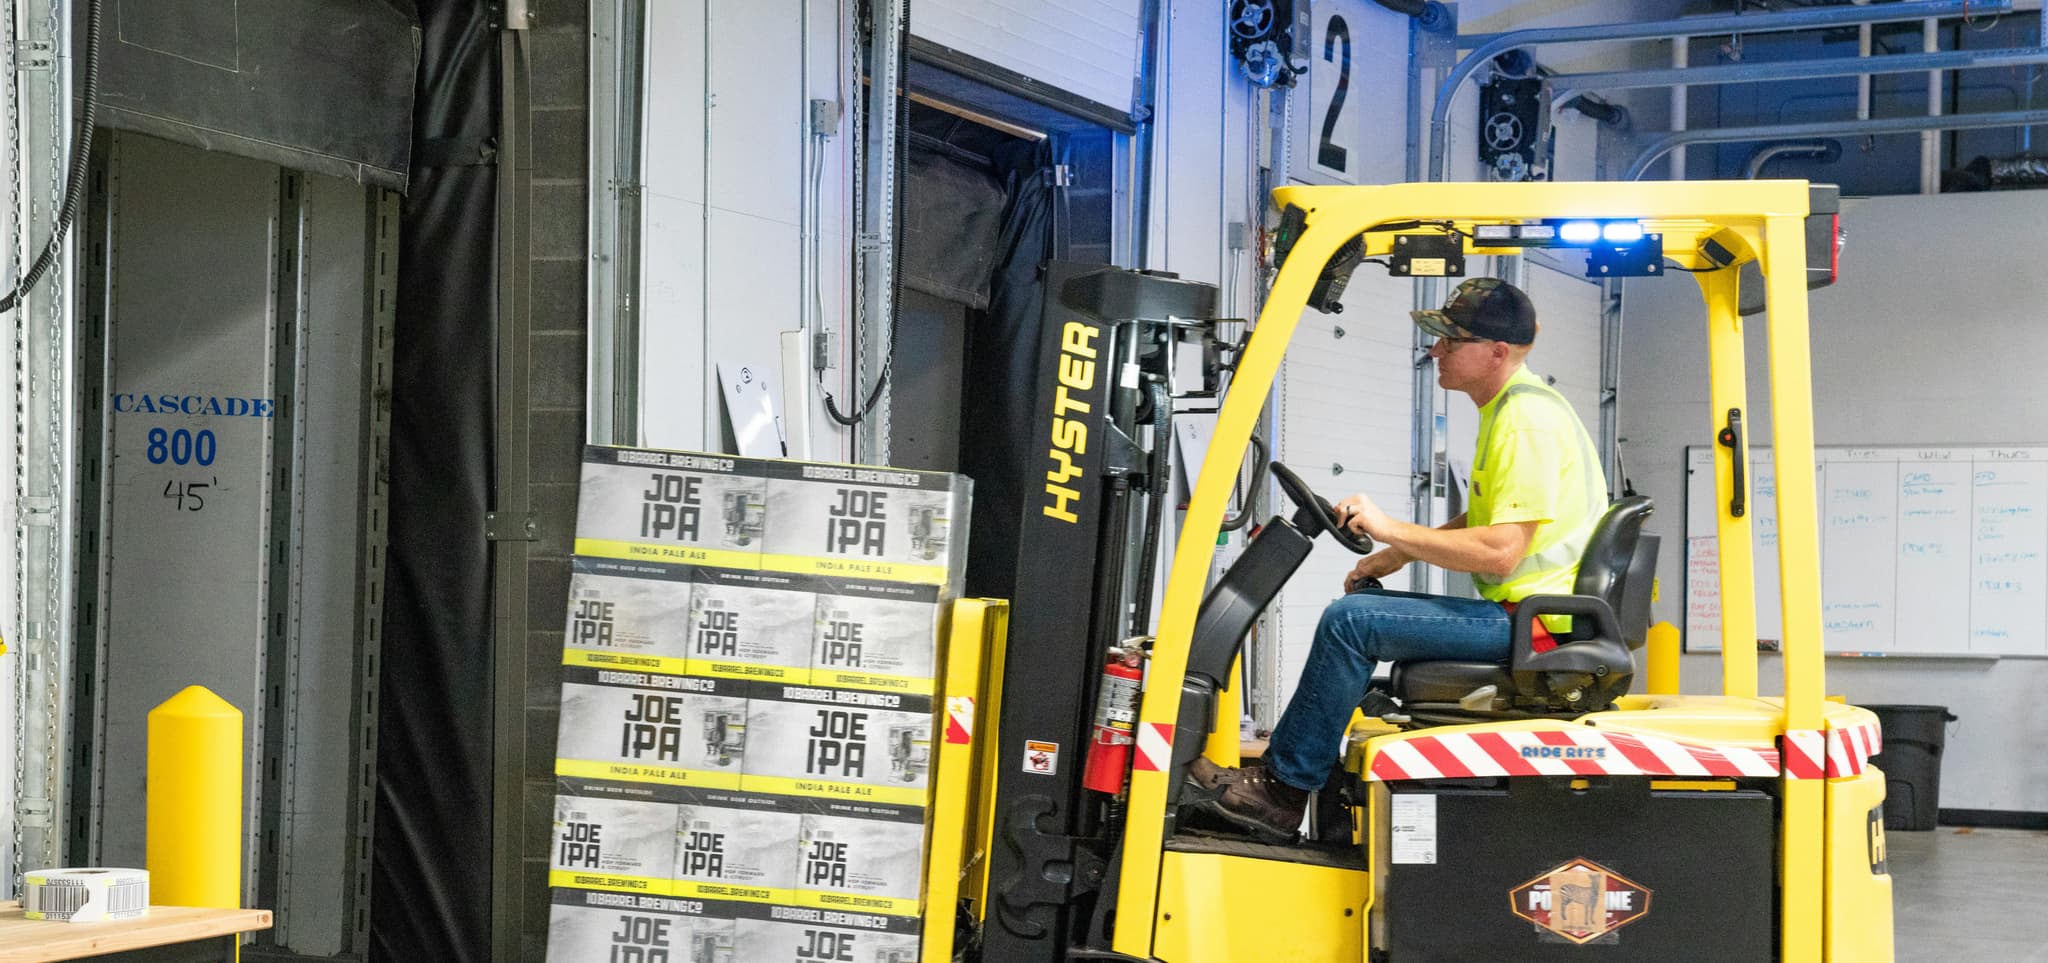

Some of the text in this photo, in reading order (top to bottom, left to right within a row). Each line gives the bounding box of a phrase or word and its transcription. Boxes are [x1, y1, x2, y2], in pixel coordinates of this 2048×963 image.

[1318, 14, 1351, 173] 2
[114, 394, 275, 418] CASCADE
[1043, 321, 1099, 524] HYSTER
[146, 427, 217, 466] 800
[163, 476, 218, 511] 45'
[644, 473, 703, 505] JOE
[829, 488, 888, 519] JOE
[640, 502, 700, 542] IPA
[826, 518, 886, 556] IPA
[630, 546, 707, 560] INDIA PALE ALE
[575, 600, 615, 621] JOE
[699, 610, 739, 631] JOE
[572, 620, 613, 646] IPA
[696, 630, 737, 656] IPA
[823, 621, 864, 642] JOE
[821, 641, 862, 667] IPA
[625, 693, 683, 725] JOE
[809, 709, 868, 741] JOE
[621, 722, 681, 762] IPA
[1521, 746, 1562, 758] RIDE
[806, 738, 866, 778] IPA
[610, 766, 687, 780] INDIA PALE ALE
[795, 782, 872, 796] INDIA PALE ALE
[562, 822, 602, 843] JOE
[685, 831, 724, 853] JOE
[559, 842, 600, 868] IPA
[682, 851, 723, 878] IPA
[808, 840, 848, 862] JOE
[805, 860, 846, 887] IPA
[612, 915, 671, 946] JOE
[796, 929, 856, 962] JOE
